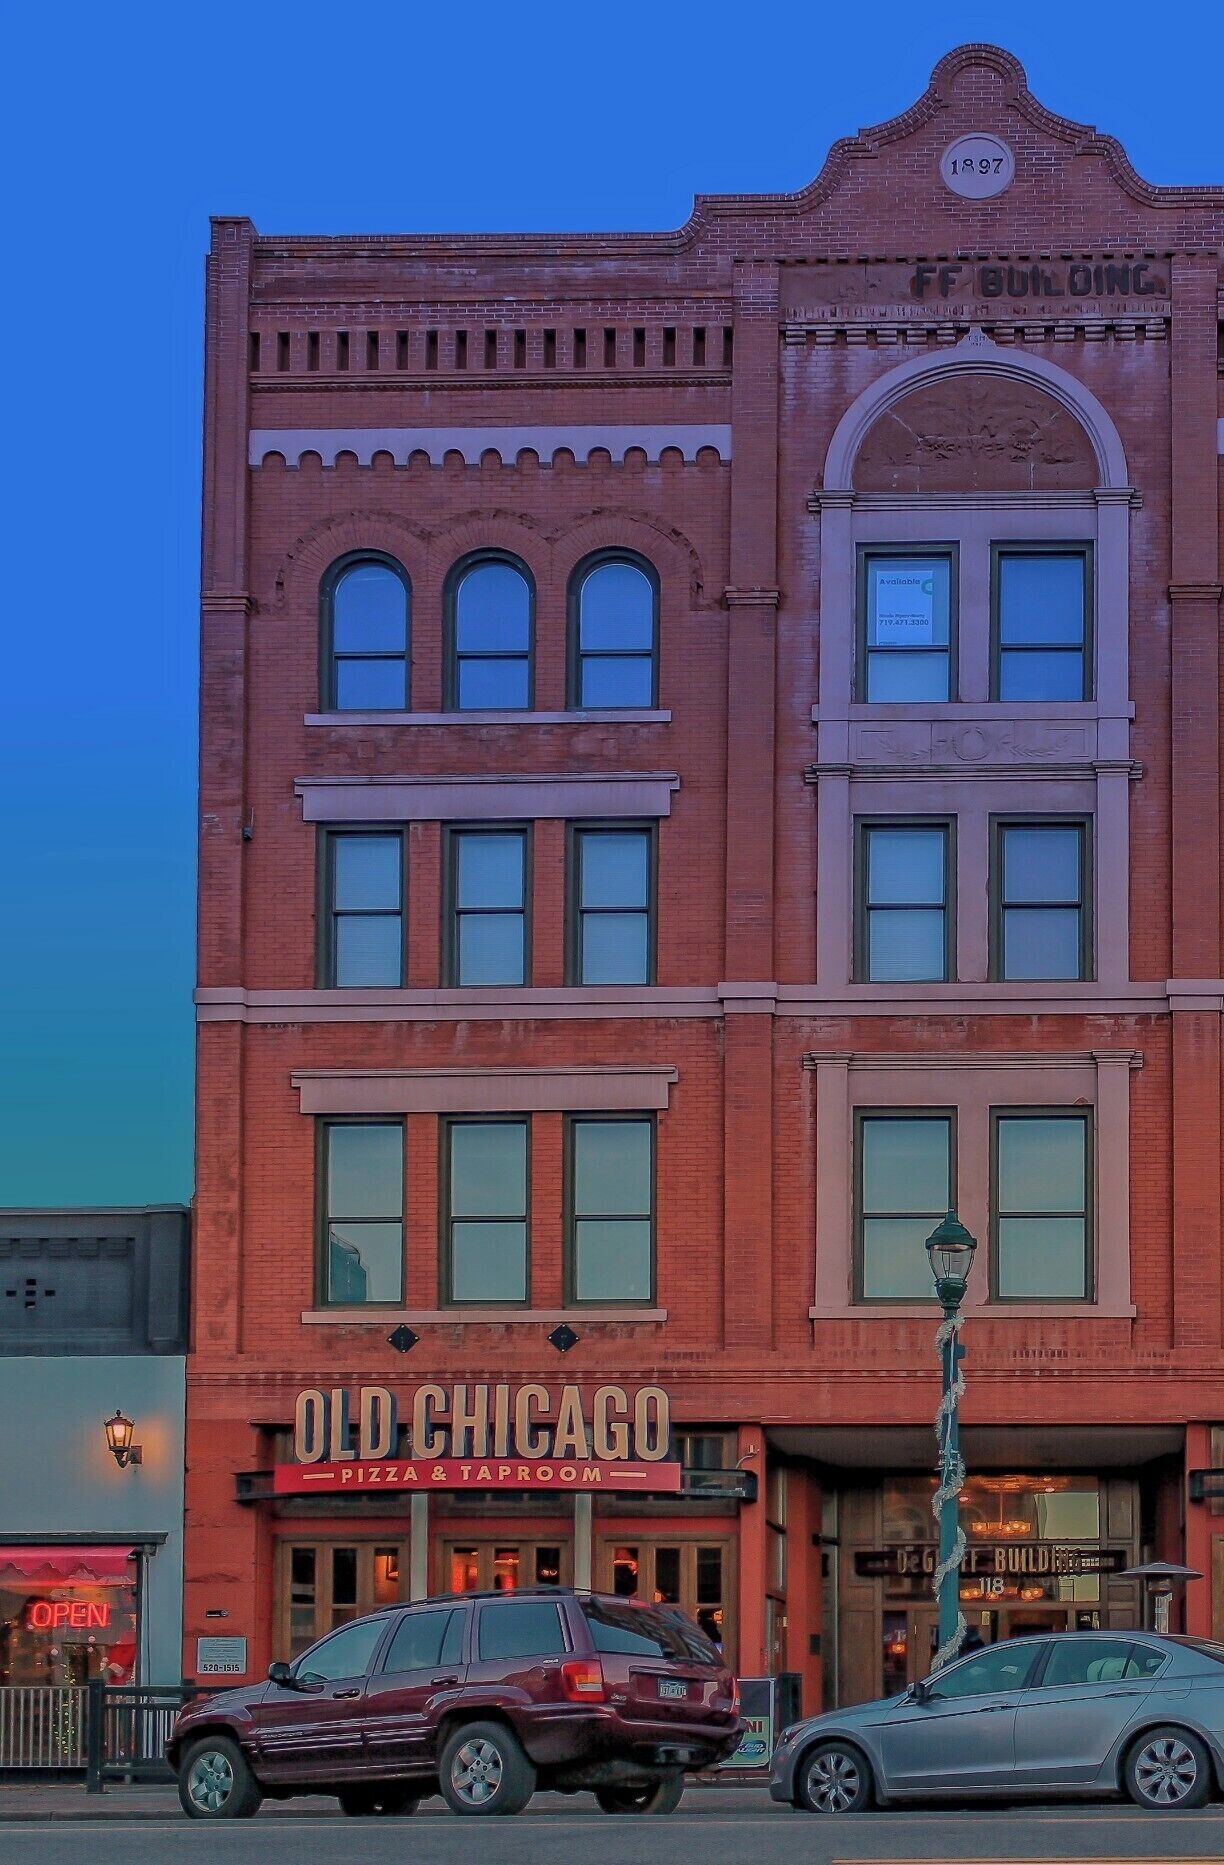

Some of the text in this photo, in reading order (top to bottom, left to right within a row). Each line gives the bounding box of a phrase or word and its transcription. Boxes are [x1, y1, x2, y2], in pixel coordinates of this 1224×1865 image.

[950, 158, 1004, 176] 1897
[295, 1384, 671, 1464] OLD CHICAGO
[340, 1465, 603, 1484] PIZZA & TAPROOM
[994, 1546, 1081, 1573] BUILDING
[978, 1577, 1005, 1595] 118
[31, 1602, 109, 1628] OPEN
[203, 1664, 240, 1672] 520-1515
